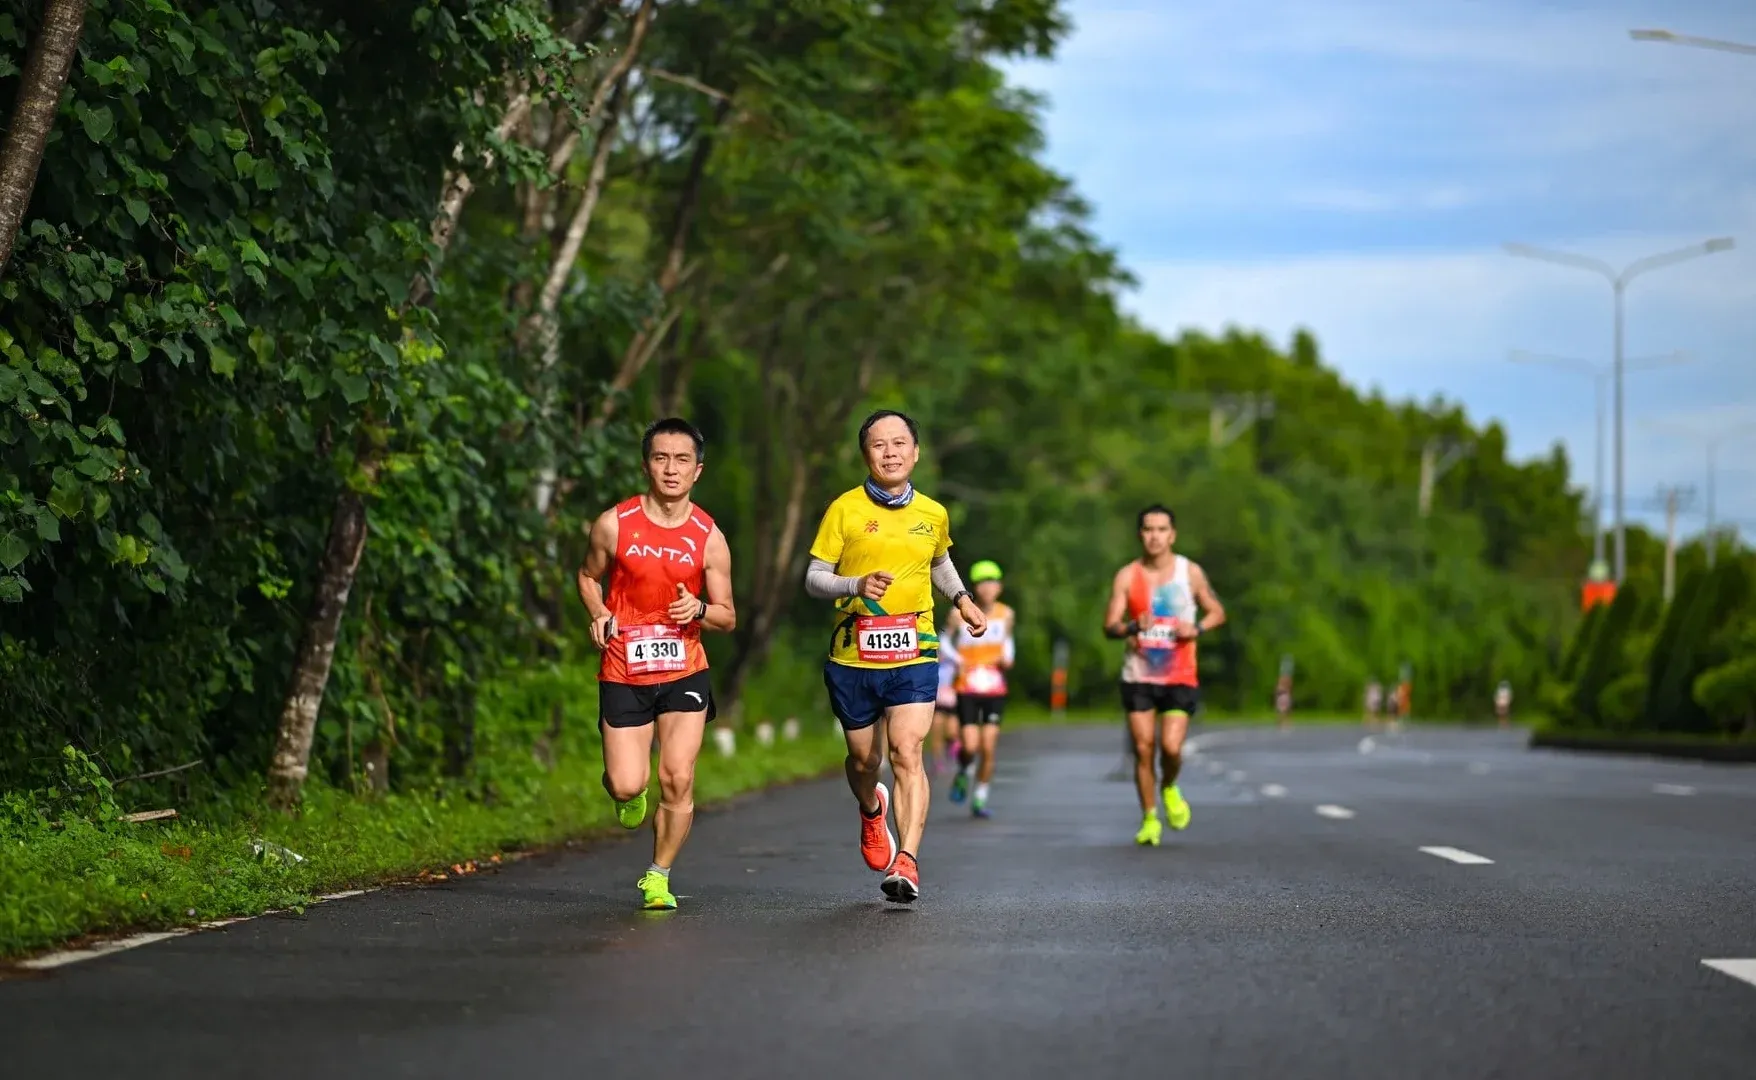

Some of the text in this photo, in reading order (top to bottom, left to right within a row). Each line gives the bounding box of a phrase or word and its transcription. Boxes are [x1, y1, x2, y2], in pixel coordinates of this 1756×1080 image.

[625, 544, 695, 567] ANTA
[866, 632, 910, 649] 41334
[634, 641, 679, 660] 4330
